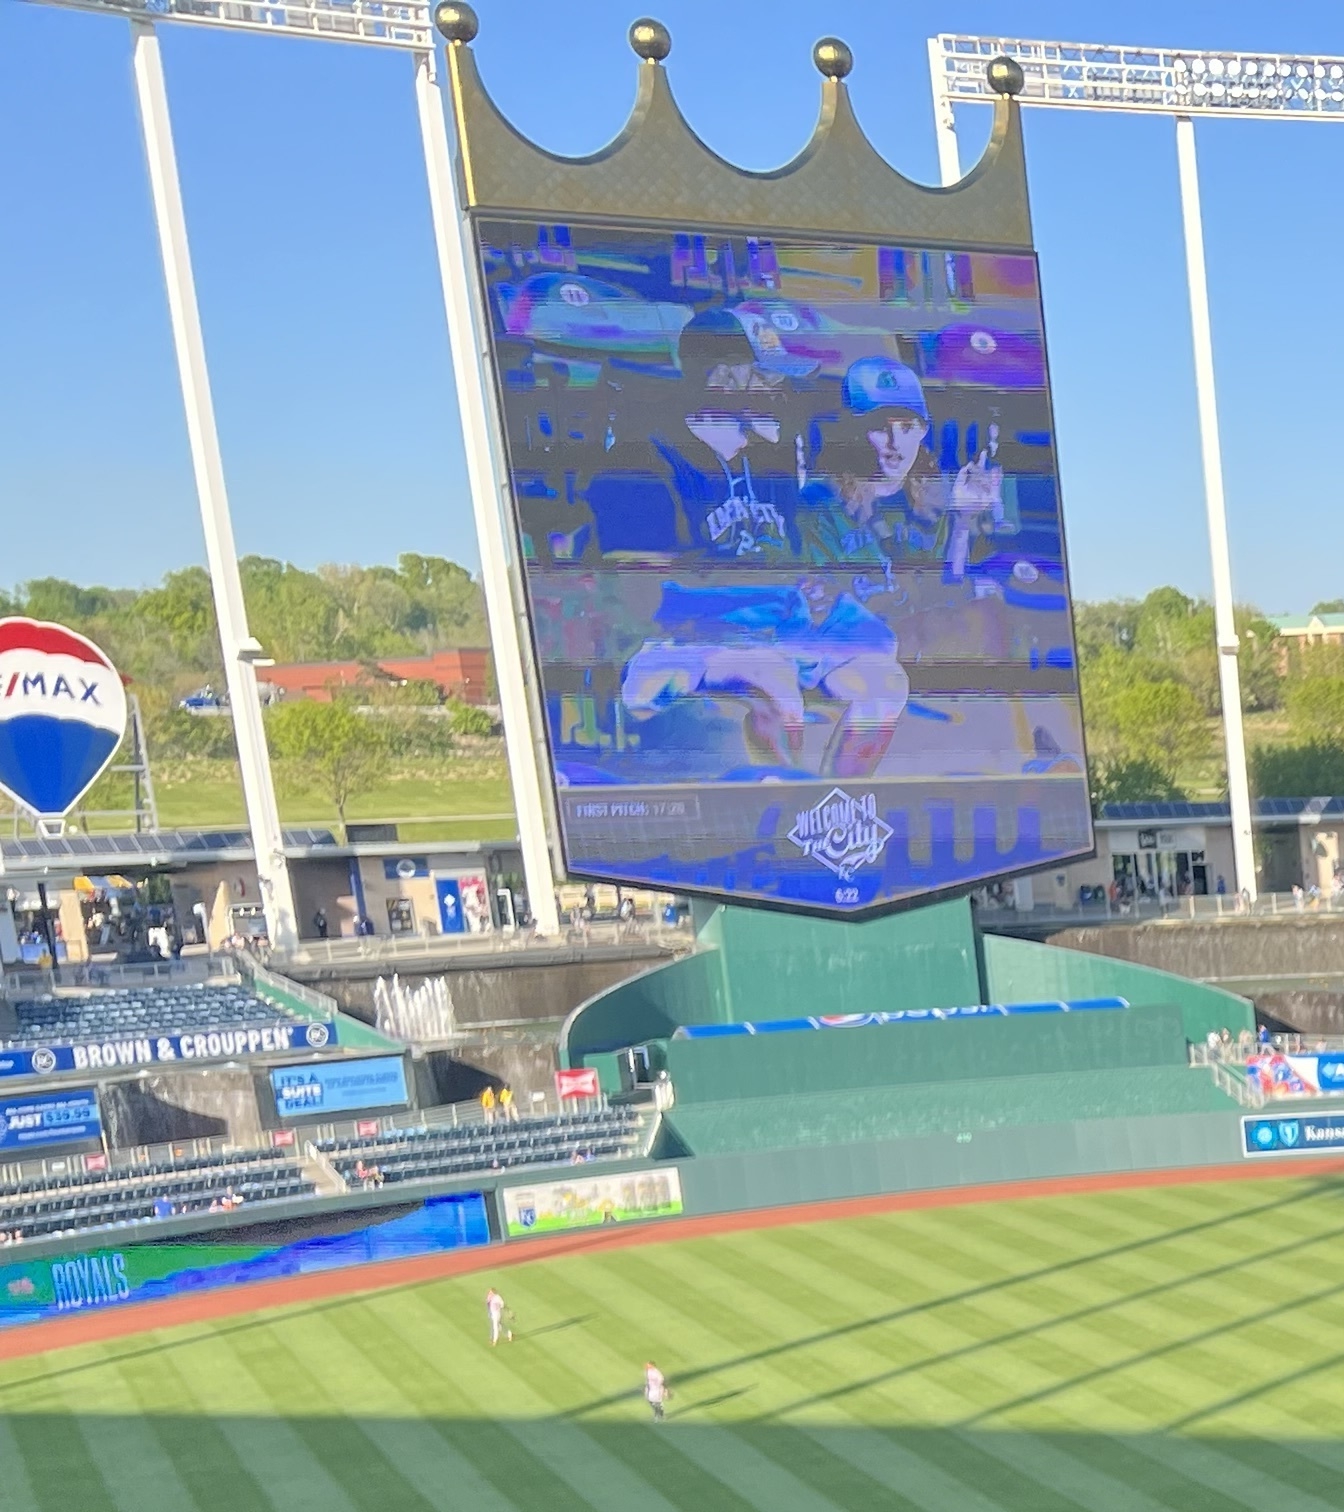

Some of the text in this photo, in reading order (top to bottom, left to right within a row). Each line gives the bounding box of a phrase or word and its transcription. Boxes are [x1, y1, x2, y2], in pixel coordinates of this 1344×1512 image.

[73, 1028, 290, 1070] BROWN & CROUPPEN
[282, 1084, 322, 1099] SUITE
[8, 1113, 42, 1131] JUST
[52, 1253, 130, 1310] ROYALS
